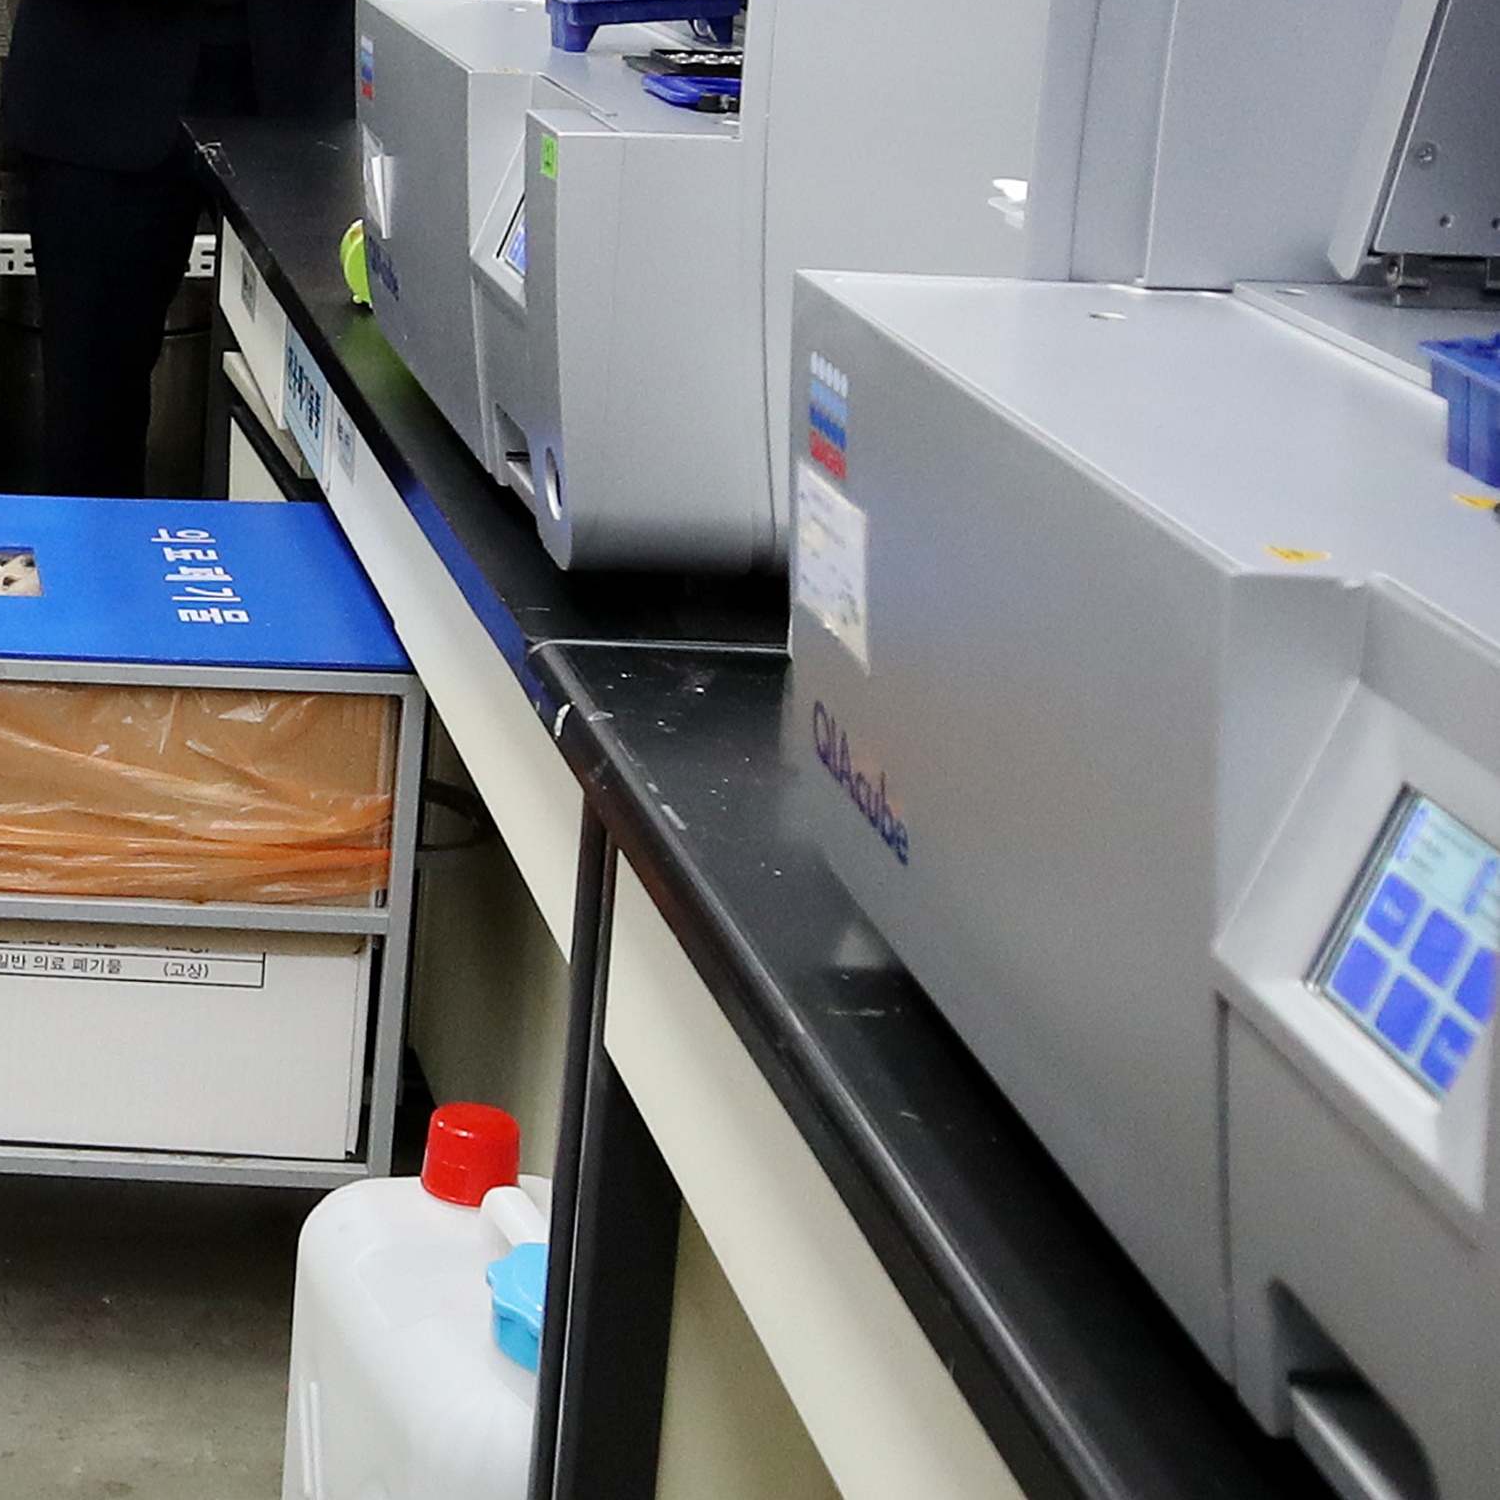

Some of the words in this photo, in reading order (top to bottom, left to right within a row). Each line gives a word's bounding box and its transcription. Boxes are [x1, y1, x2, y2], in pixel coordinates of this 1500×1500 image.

[813, 700, 908, 866] QIAcube
[33, 956, 66, 971] 의료
[71, 958, 124, 975] 폐기물
[162, 963, 210, 979] (고상)
